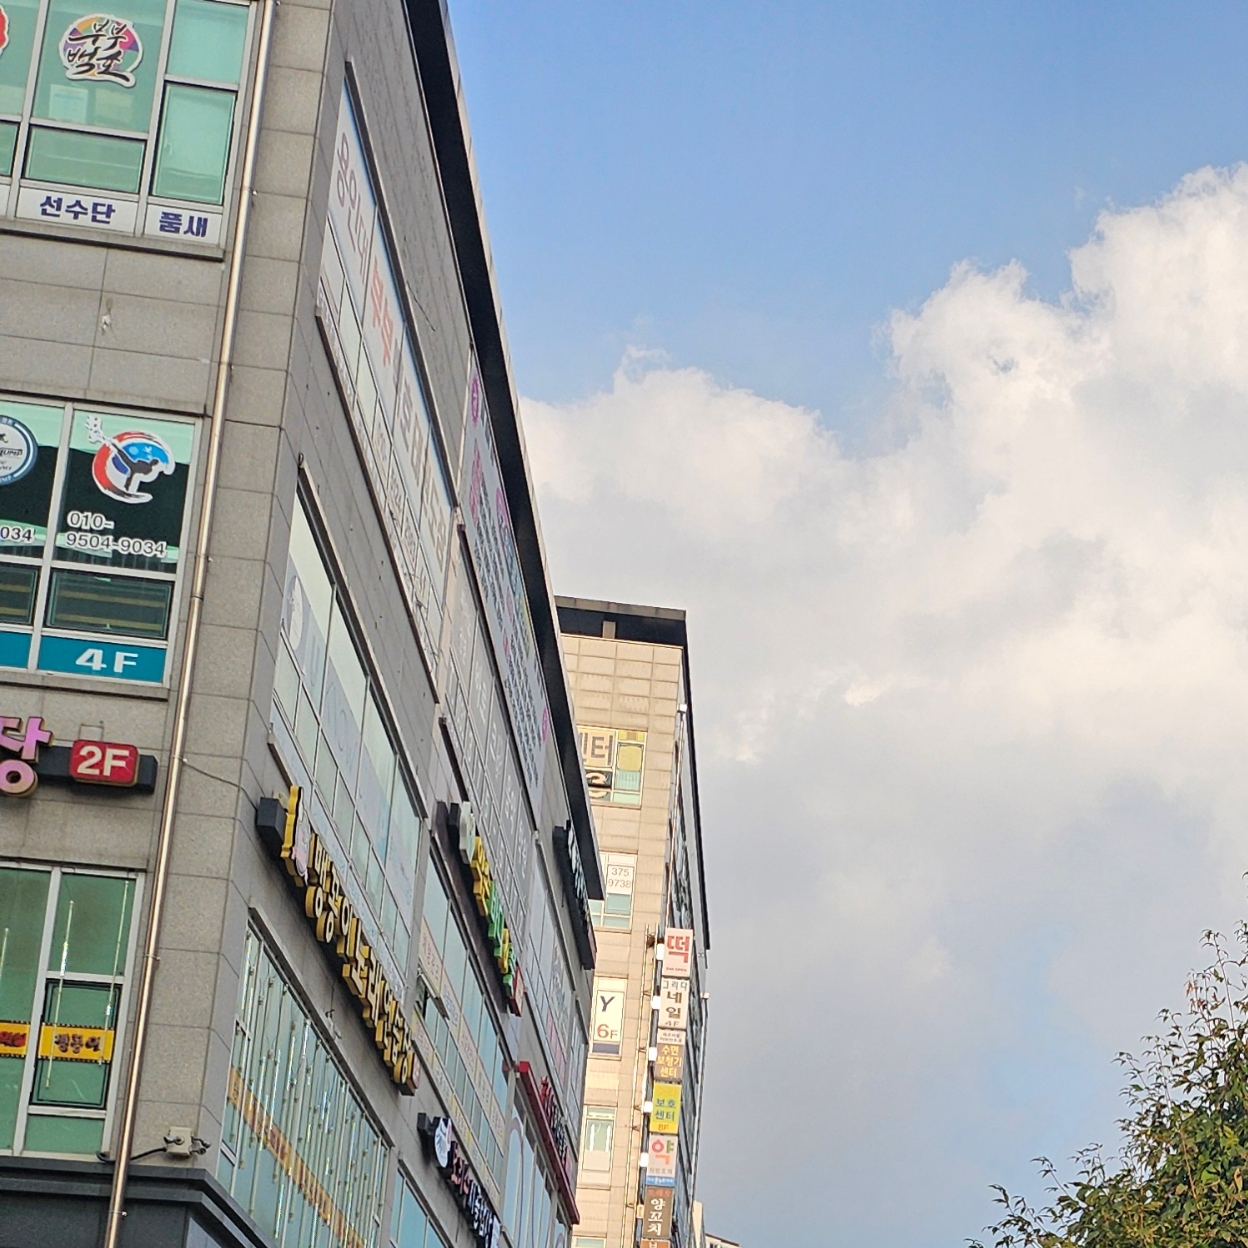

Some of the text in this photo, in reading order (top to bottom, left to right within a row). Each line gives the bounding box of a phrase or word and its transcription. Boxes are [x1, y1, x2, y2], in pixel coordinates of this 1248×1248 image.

[39, 195, 116, 225] 선수단
[159, 211, 209, 238] 품새
[67, 511, 114, 530] 010-
[66, 533, 168, 559] 9504-9034
[76, 648, 139, 674] 4F
[77, 745, 130, 777] 2F
[611, 867, 630, 877] 375
[668, 935, 690, 963] 떡
[600, 995, 615, 1013] Y
[666, 991, 682, 1020] 네일
[597, 1024, 618, 1040] 6F
[656, 1057, 682, 1067] 보청기
[662, 1045, 679, 1056] 수면
[660, 1067, 677, 1078] 센터
[655, 1111, 675, 1121] 센터
[652, 1139, 674, 1165] 약
[648, 1198, 667, 1236] 양꼬치
